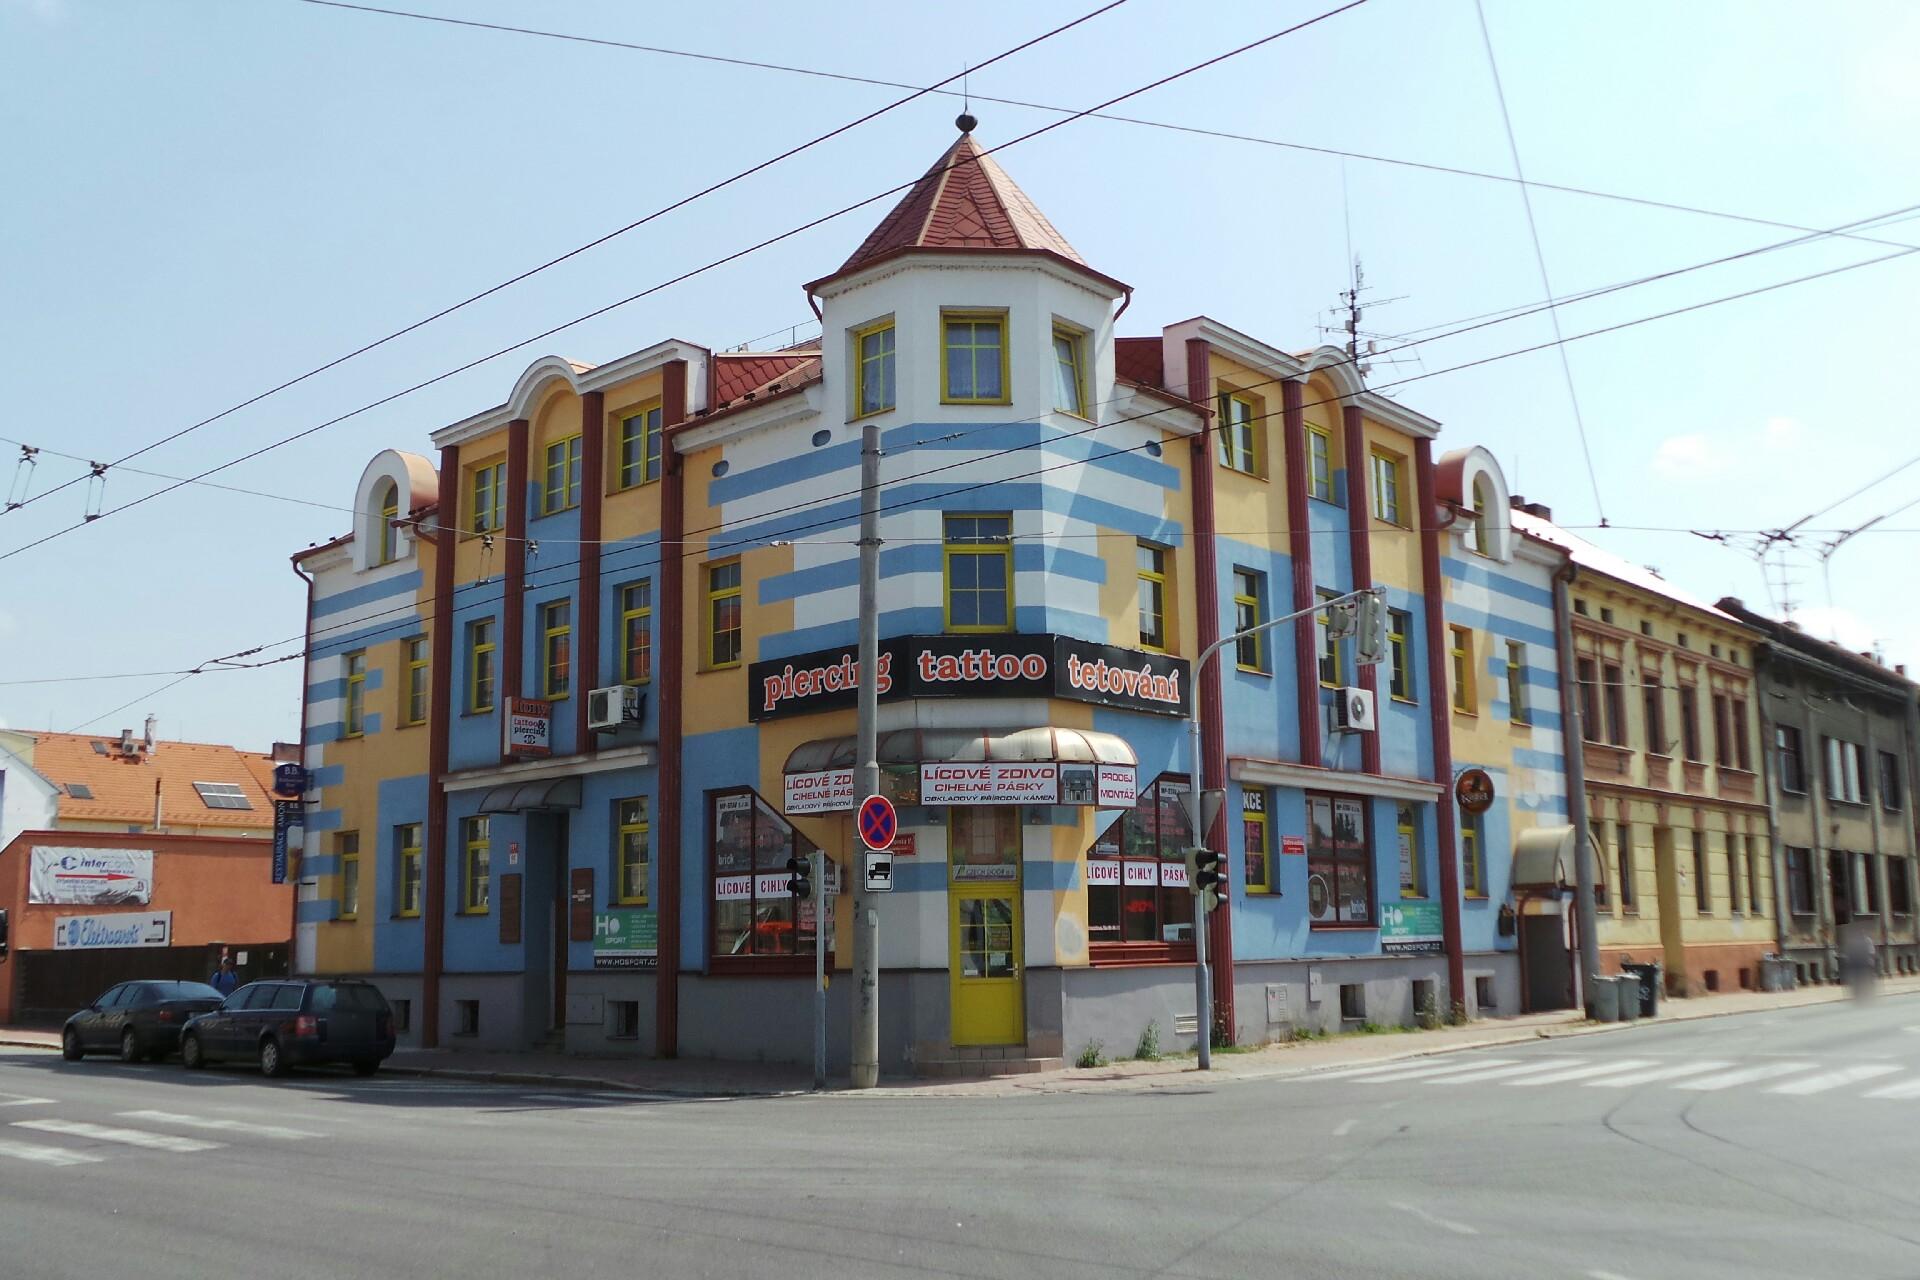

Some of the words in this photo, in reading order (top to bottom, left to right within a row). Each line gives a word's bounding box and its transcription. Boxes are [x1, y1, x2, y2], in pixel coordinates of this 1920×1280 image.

[917, 649, 1047, 682] tattoo
[1067, 653, 1180, 704] tetování
[514, 726, 546, 737] piercing
[924, 766, 991, 780] LÍCOVÉ
[997, 768, 1055, 779] ZDIVO
[1101, 772, 1133, 782] PRODEJ
[786, 773, 830, 790] LÍCOVÉ
[934, 781, 992, 792] CIHELNÉ
[996, 781, 1044, 791] PÁSKY
[792, 788, 830, 801] CIHELNÉ
[924, 794, 978, 802] OBKLADOVÝ
[1100, 788, 1135, 799] MONTÁŽ
[1128, 867, 1153, 880] CIHLY
[718, 878, 751, 895] LÍCOVÉ
[760, 879, 788, 893] CIHLY
